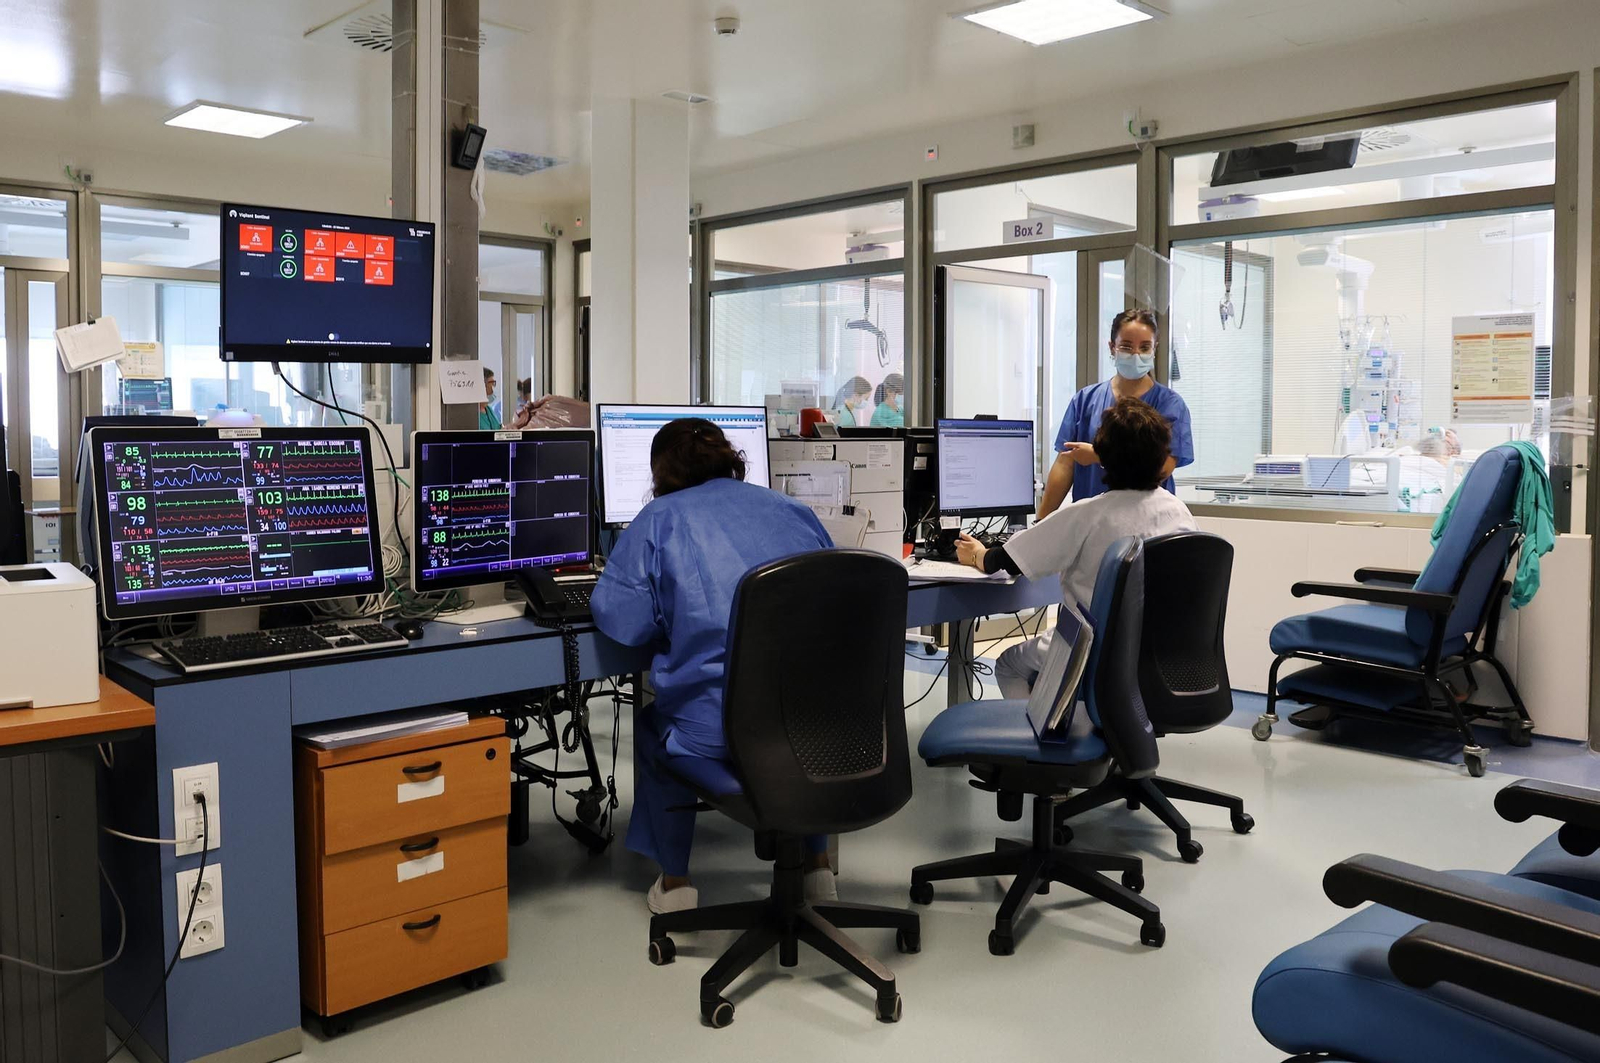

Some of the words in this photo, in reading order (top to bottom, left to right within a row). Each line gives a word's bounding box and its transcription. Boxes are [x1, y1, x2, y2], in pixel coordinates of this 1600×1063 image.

[1014, 225, 1033, 237] Box
[1036, 222, 1043, 235] 2
[125, 446, 139, 456] 85
[257, 446, 273, 459] 77
[121, 481, 131, 489] 84
[256, 476, 264, 485] 99
[258, 492, 282, 504] 103
[430, 490, 449, 502] 138
[127, 497, 146, 510] 98
[131, 516, 145, 525] 79
[260, 522, 269, 531] 34
[274, 522, 287, 530] 100
[434, 532, 446, 543] 88
[130, 545, 151, 555] 135
[442, 558, 449, 566] 22
[128, 580, 142, 589] 135
